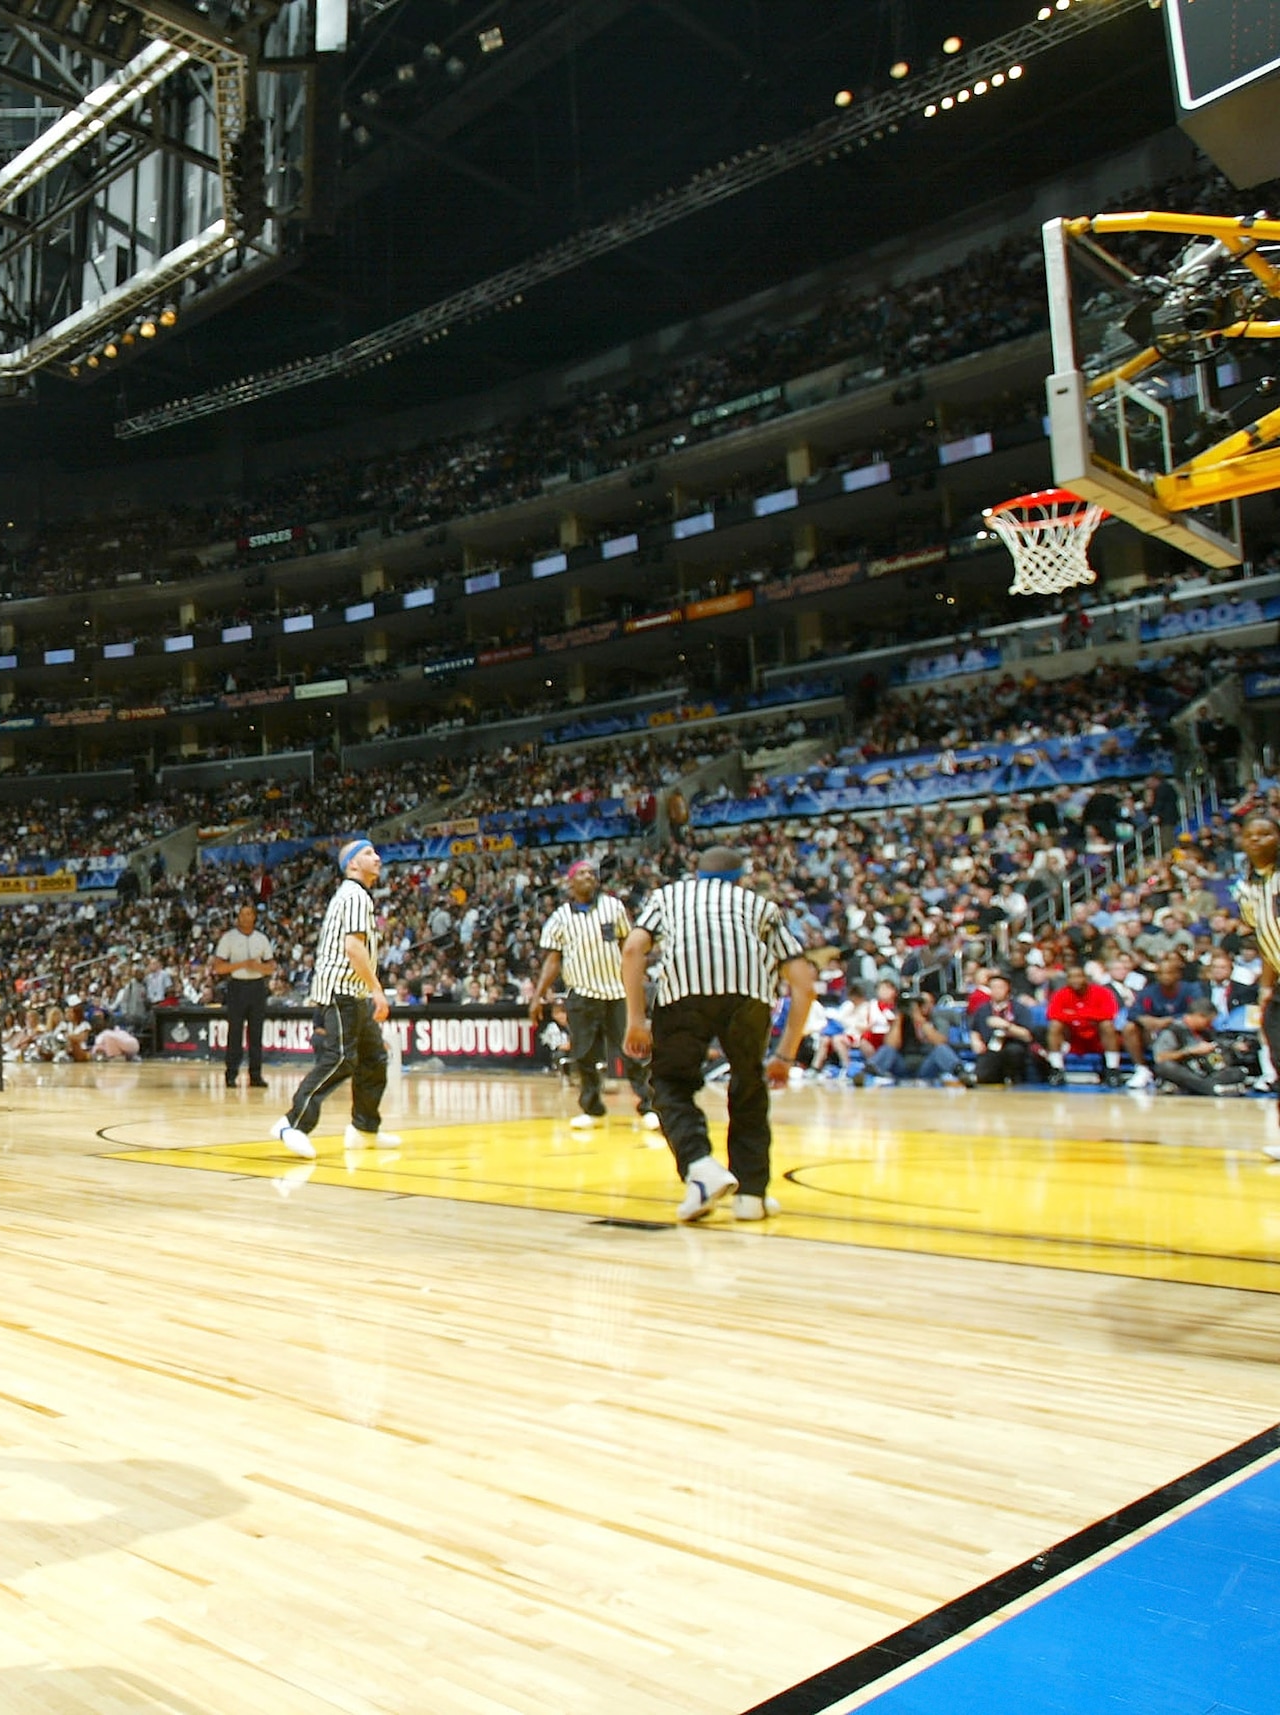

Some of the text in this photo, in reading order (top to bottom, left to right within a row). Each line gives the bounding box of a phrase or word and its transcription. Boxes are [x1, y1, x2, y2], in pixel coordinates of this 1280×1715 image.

[249, 528, 293, 549] STAPLES
[261, 1019, 316, 1053] OCKE
[415, 1018, 537, 1056] SHOOTOUT
